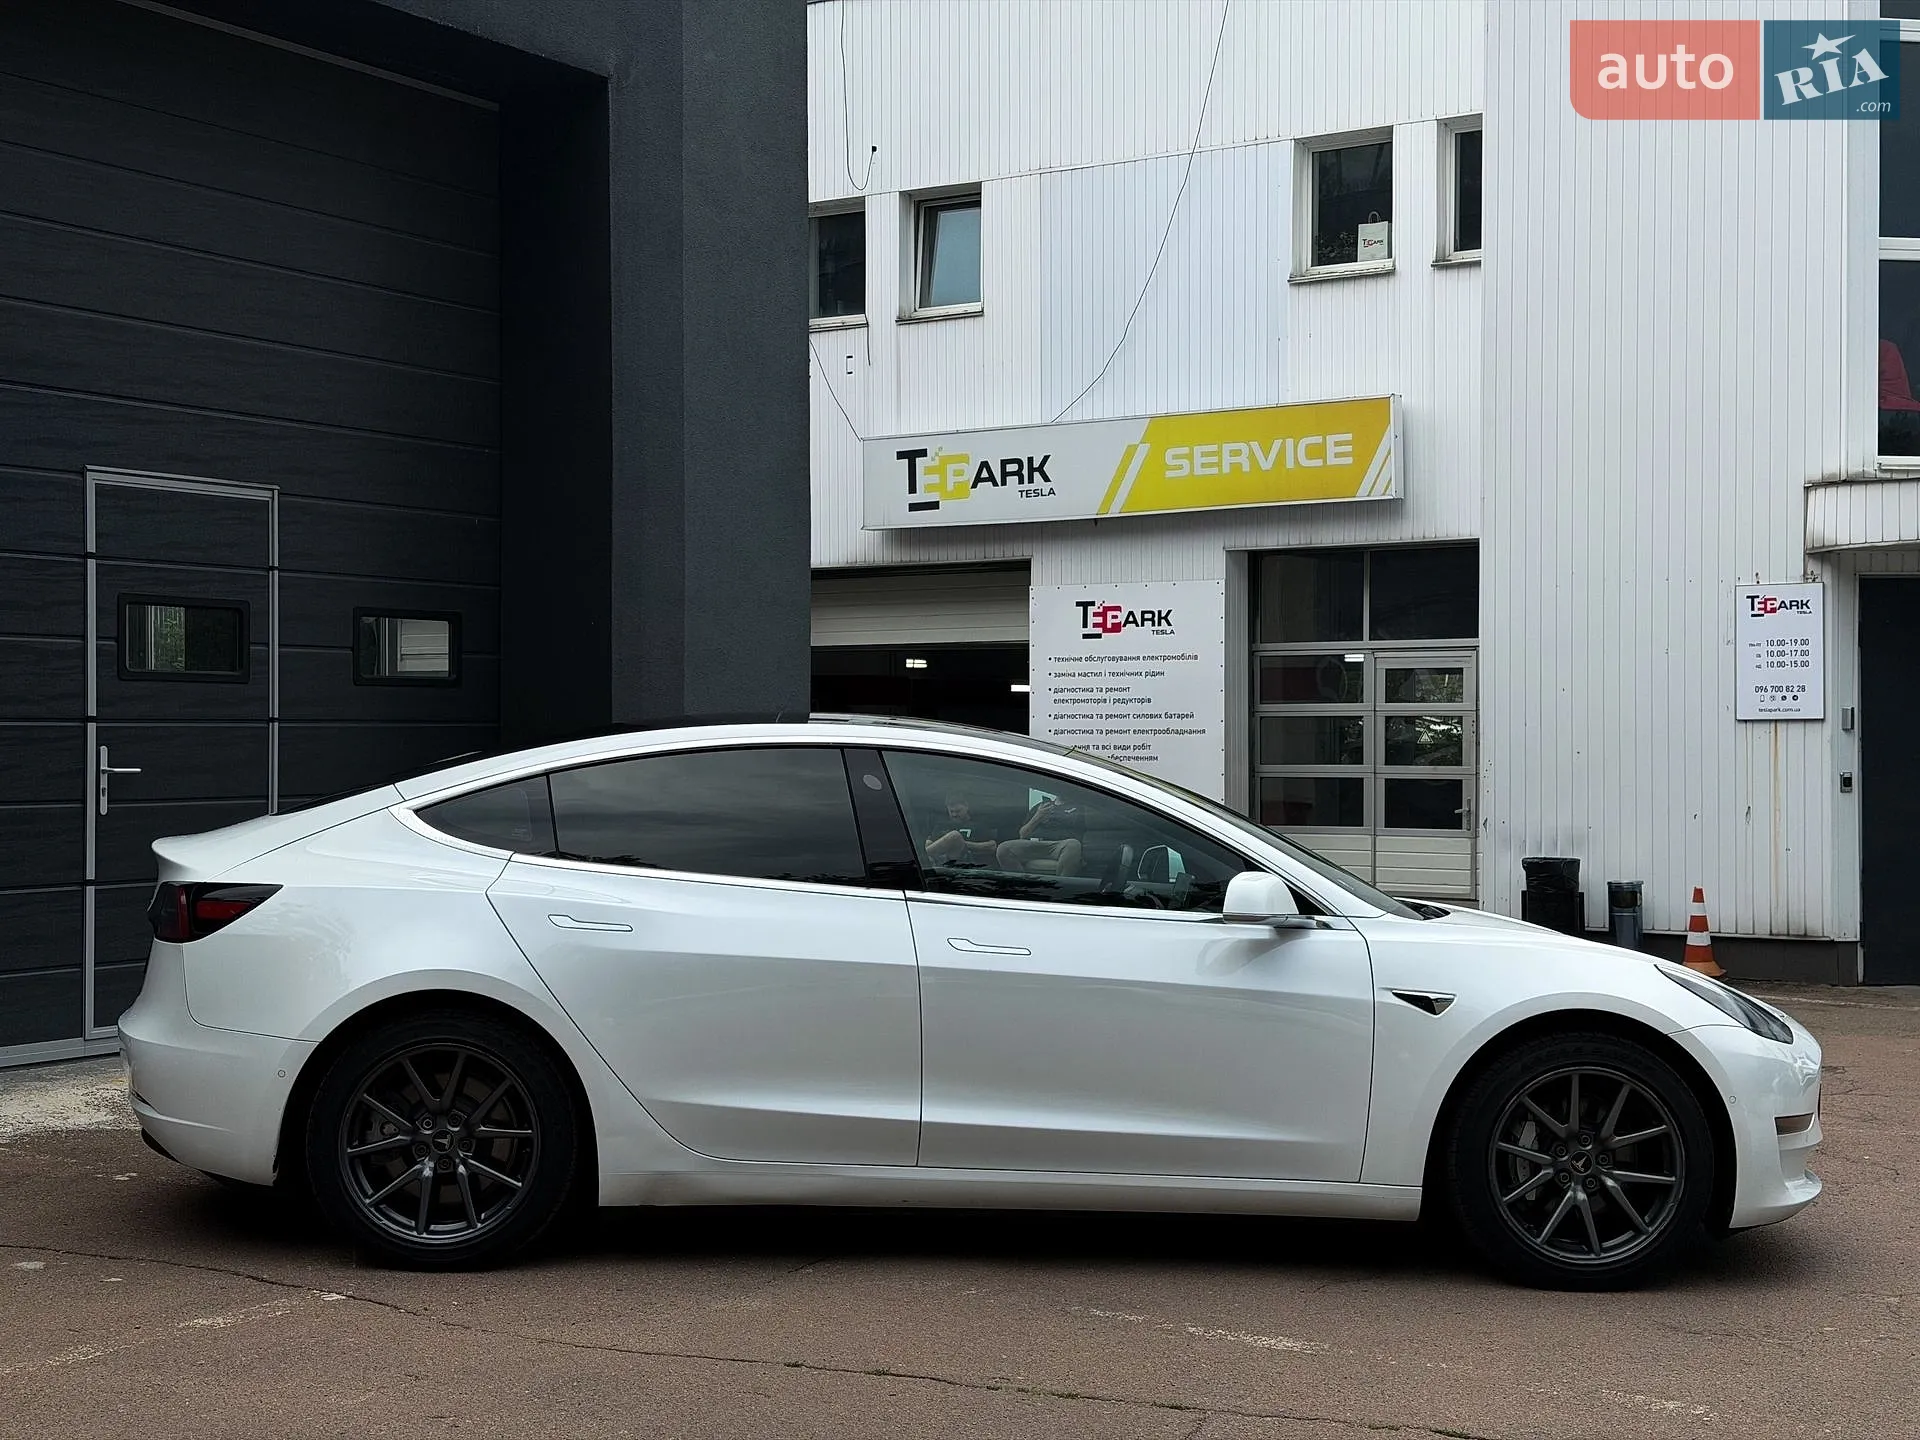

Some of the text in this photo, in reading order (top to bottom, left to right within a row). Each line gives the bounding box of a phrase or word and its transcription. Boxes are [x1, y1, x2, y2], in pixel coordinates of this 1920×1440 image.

[1164, 432, 1353, 479] SERVICE
[1018, 487, 1056, 499] TESLA
[1766, 638, 1810, 647] 10.00-19.00
[1053, 652, 1199, 664] технічне обслуговування електромобілів
[1766, 649, 1810, 658] 10.00-17.00
[1766, 660, 1810, 669] 10.00-15.00
[1053, 669, 1076, 678] заміна
[1108, 668, 1143, 678] технічних
[1144, 669, 1165, 679] рідин
[1053, 685, 1094, 694] діагностика
[1105, 686, 1131, 695] ремонт
[1754, 685, 1806, 693] 096 700 82 28
[1053, 695, 1108, 706] електромоторів
[1112, 695, 1152, 706] редукторів
[1053, 712, 1094, 721] діагностика
[1105, 713, 1131, 721] ремонт
[1164, 711, 1195, 721] батарей
[1053, 727, 1094, 736] діагностика
[1105, 728, 1131, 736] ремонт
[1132, 726, 1206, 736] електрообладнання
[1101, 742, 1112, 751] всі
[1113, 744, 1131, 752] види
[1132, 742, 1152, 752] робіт
